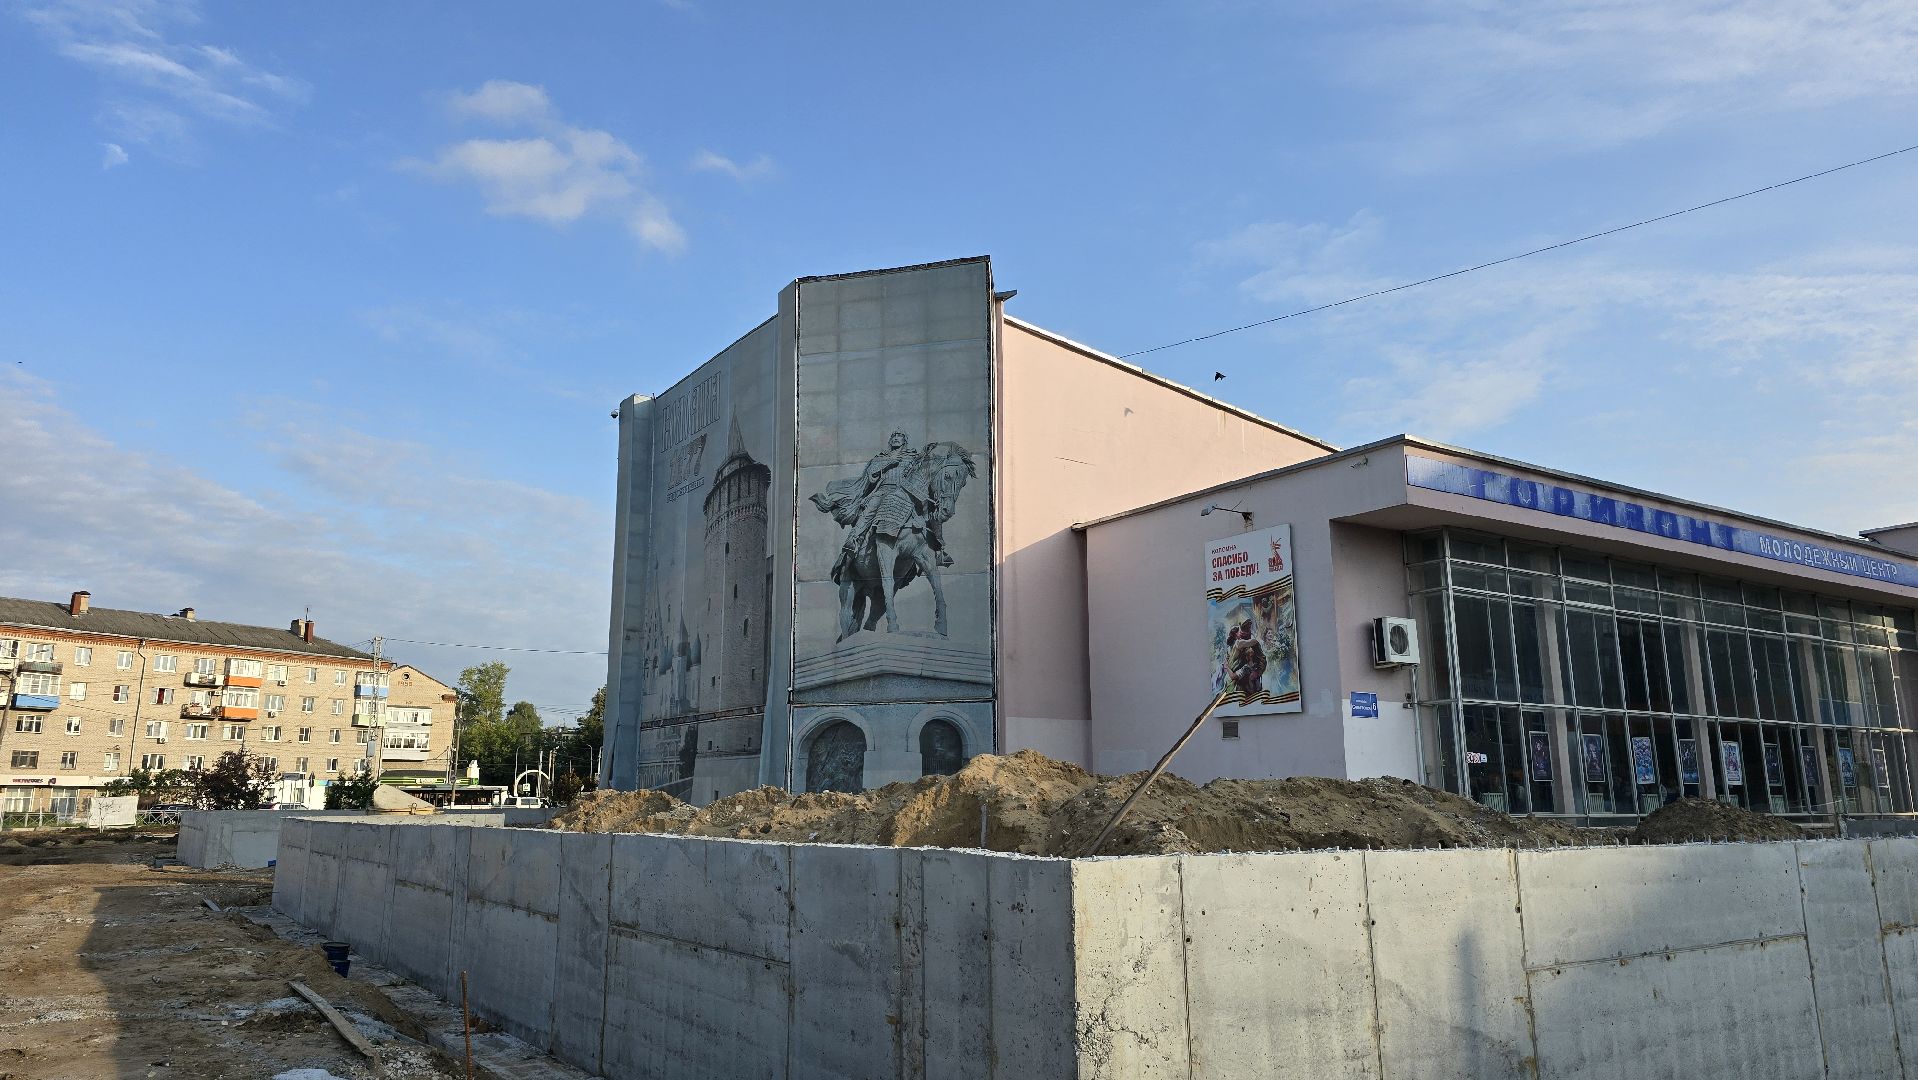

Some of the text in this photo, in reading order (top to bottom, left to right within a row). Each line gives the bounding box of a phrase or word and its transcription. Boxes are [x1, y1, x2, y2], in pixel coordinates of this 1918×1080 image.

[1212, 551, 1249, 569] СПАСИБО
[1861, 558, 1898, 579] ЦЕНТР
[1212, 571, 1223, 582] ЗА
[1225, 563, 1260, 580] ПОБЕДУ!
